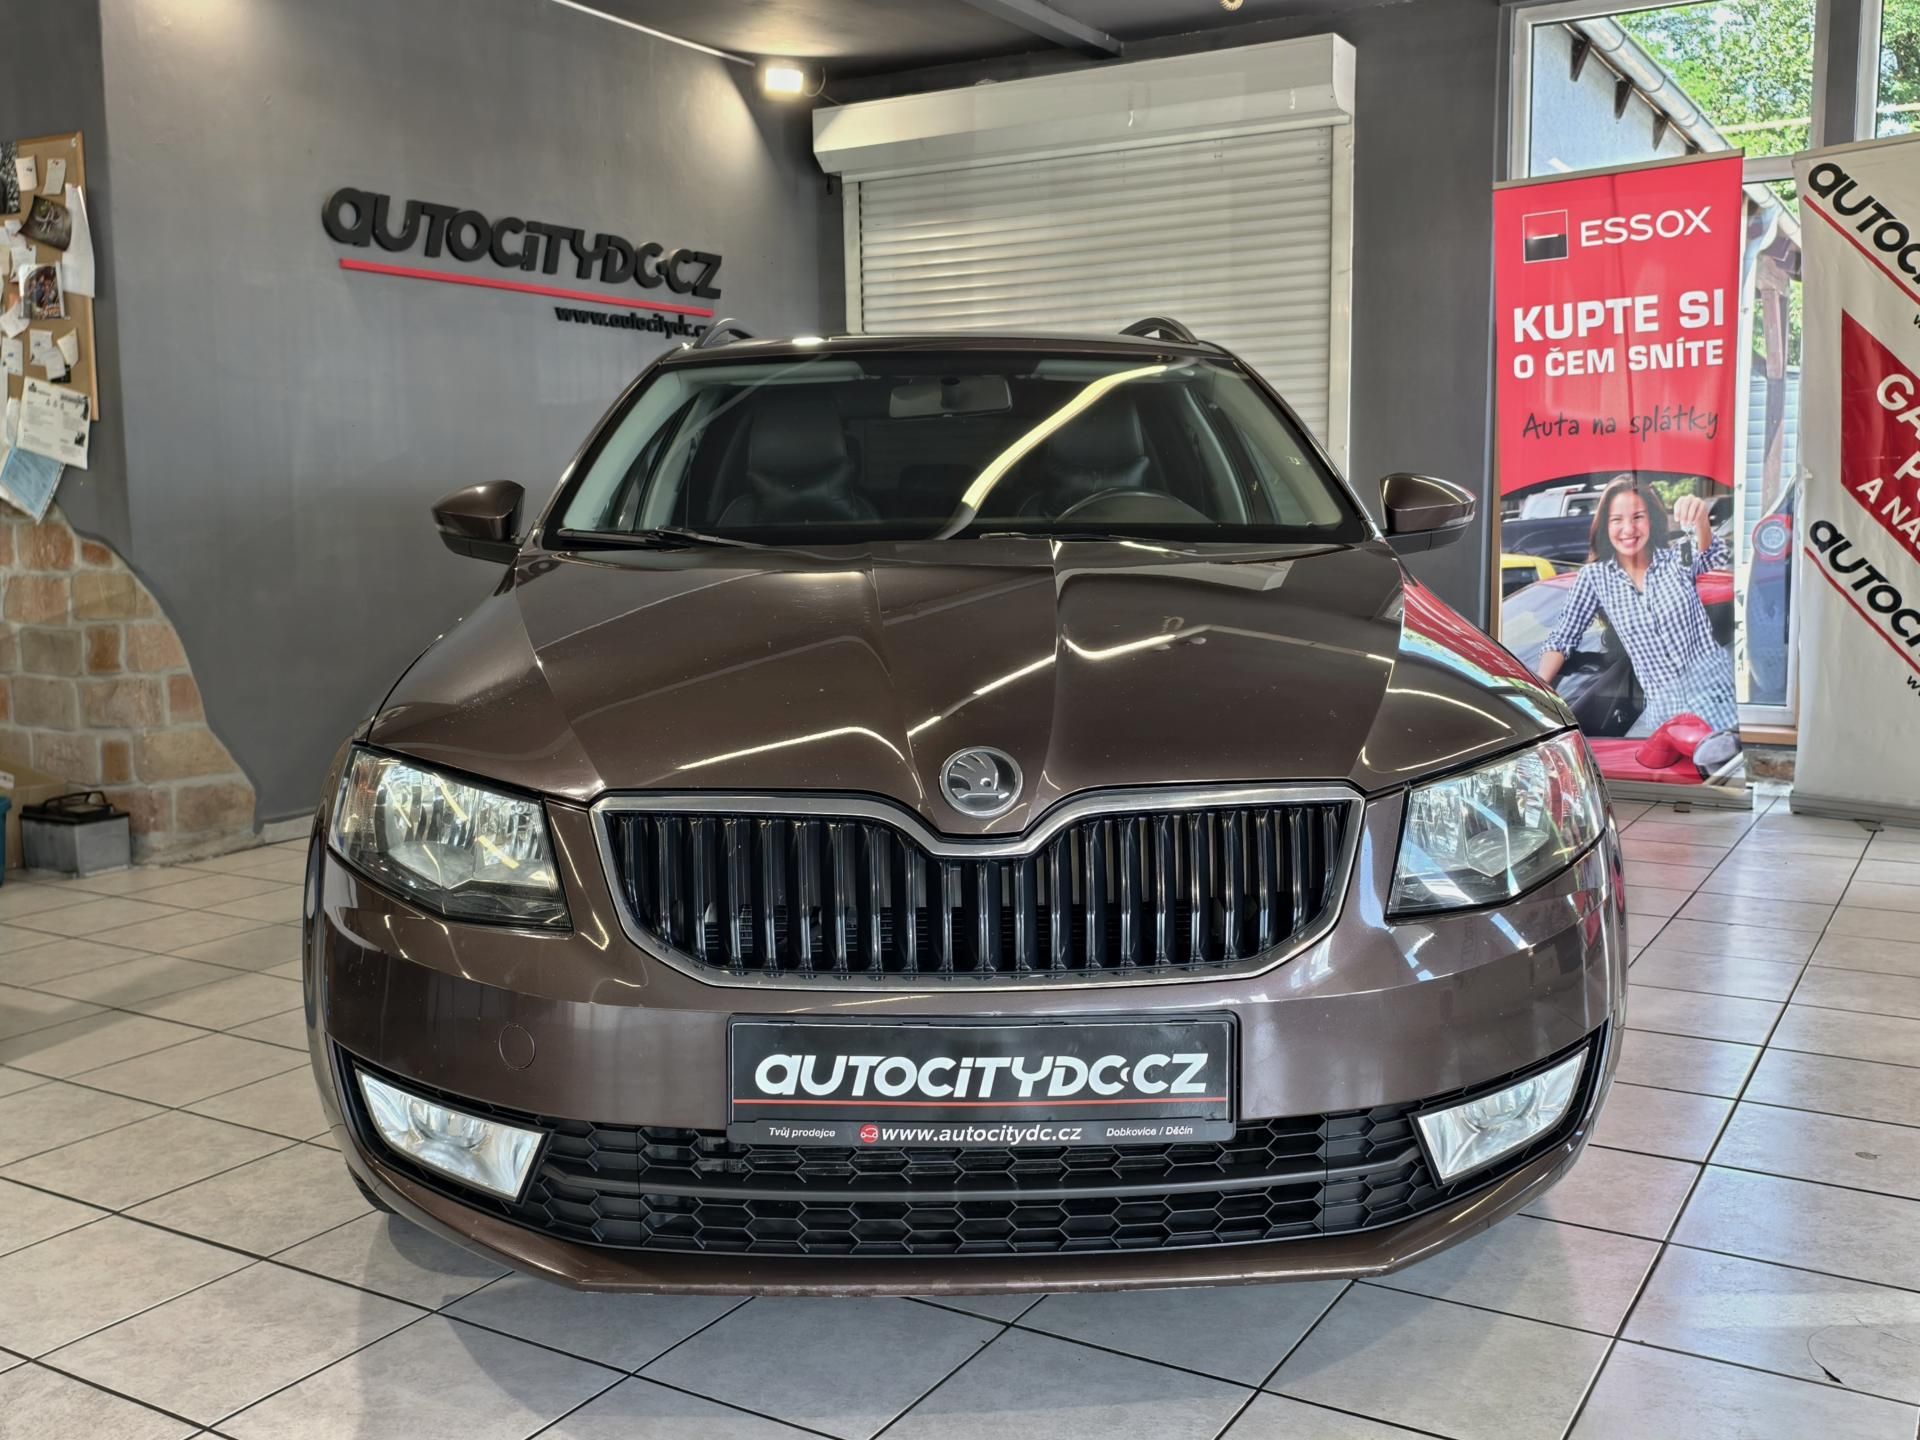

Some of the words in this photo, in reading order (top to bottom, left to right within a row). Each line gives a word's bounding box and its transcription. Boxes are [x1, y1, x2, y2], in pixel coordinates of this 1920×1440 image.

[1580, 206, 1712, 247] ESSOX
[554, 306, 708, 339] www.autocitydc.c
[1513, 294, 1659, 342] KUPTE
[1679, 288, 1724, 328] SI
[1513, 354, 1534, 379] O
[1545, 347, 1615, 377] ČEM
[1628, 337, 1724, 371] SNÍTE
[1522, 412, 1580, 438] Auta
[1593, 415, 1617, 436] na
[1630, 403, 1719, 442] splátky
[1856, 477, 1884, 504] A
[1880, 495, 1920, 552] NA
[768, 1127, 790, 1138] Tvůj
[792, 1128, 836, 1138] prodejce
[881, 1124, 1082, 1145] www.autocitydc.cz
[1106, 1126, 1157, 1137] Dobkovice
[1165, 1125, 1193, 1136] Děčín
